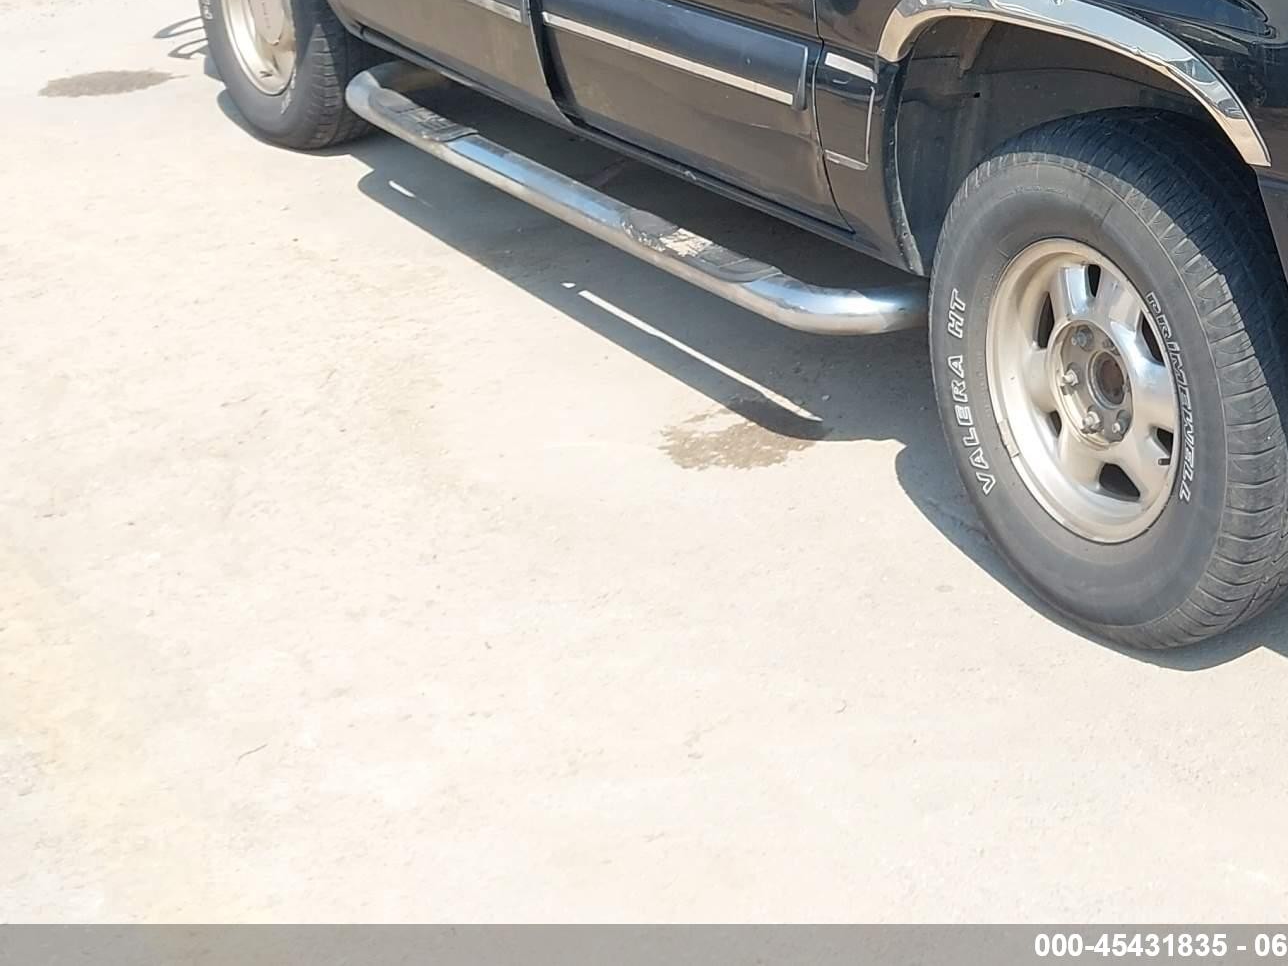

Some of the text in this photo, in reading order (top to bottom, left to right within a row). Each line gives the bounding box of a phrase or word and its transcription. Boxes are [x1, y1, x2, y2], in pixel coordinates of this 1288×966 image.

[946, 288, 995, 495] VALERA HT
[1145, 290, 1198, 503] PRIMEWELL
